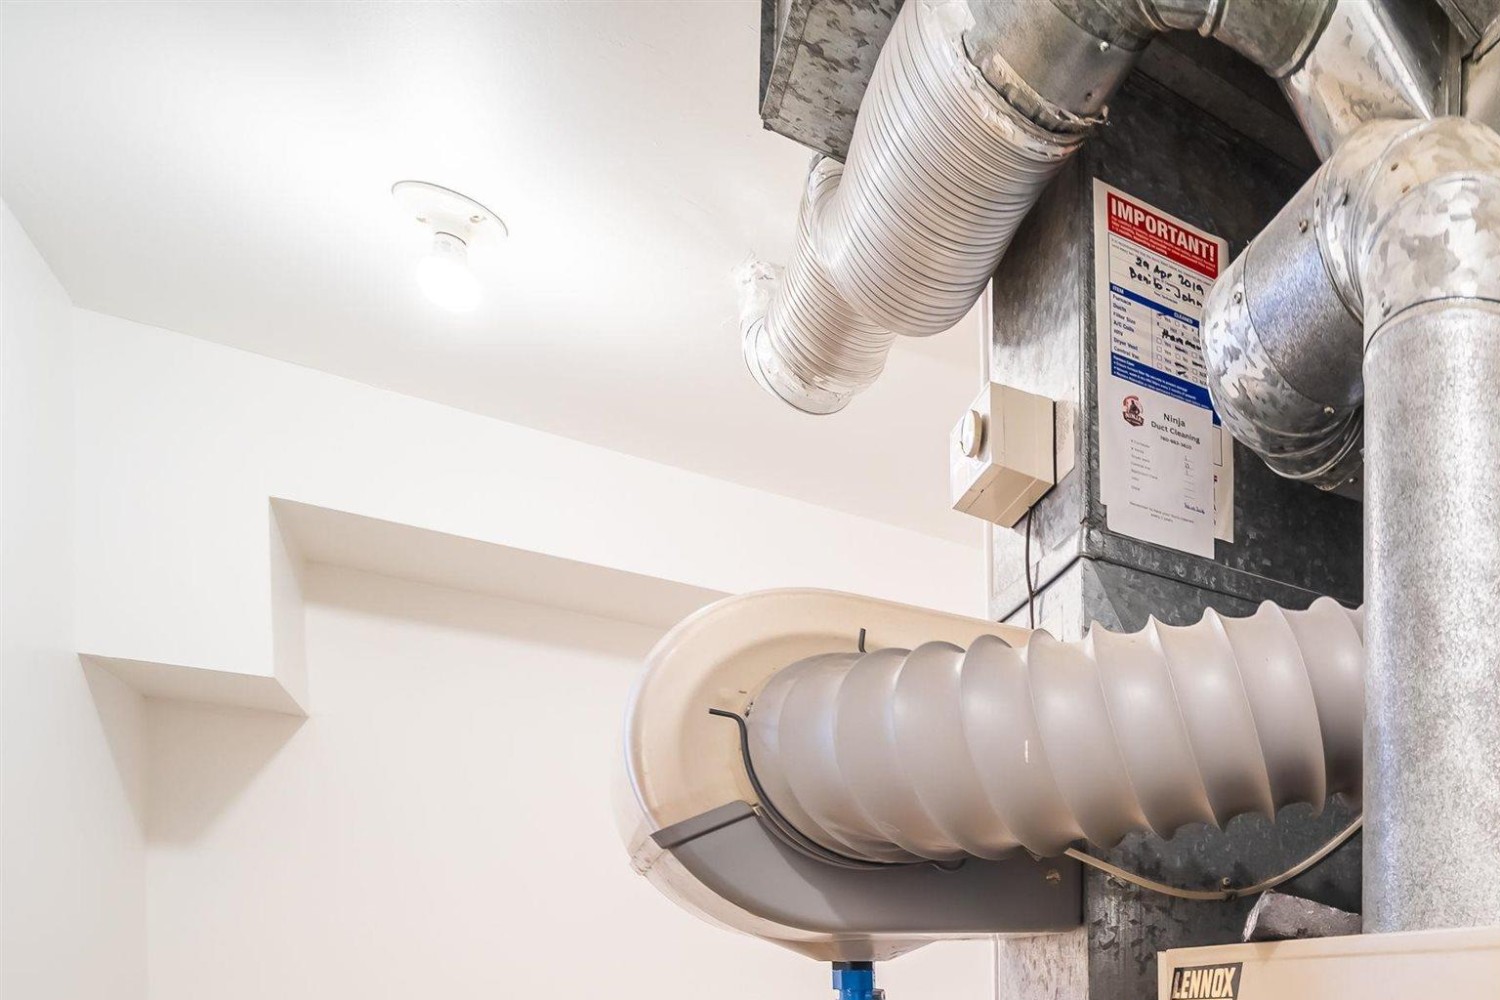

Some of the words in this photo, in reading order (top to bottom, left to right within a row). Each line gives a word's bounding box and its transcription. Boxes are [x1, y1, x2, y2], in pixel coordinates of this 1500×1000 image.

[1111, 198, 1215, 261] IMPORTANT!
[1135, 256, 1150, 270] 29
[1153, 265, 1172, 279] Apr
[1178, 275, 1205, 295] 2019
[1112, 286, 1124, 295] ITEM
[1151, 420, 1168, 433] Duct
[1169, 427, 1200, 445] Cleaning
[1163, 413, 1186, 427] Ninja
[1173, 967, 1237, 999] LENNOX
